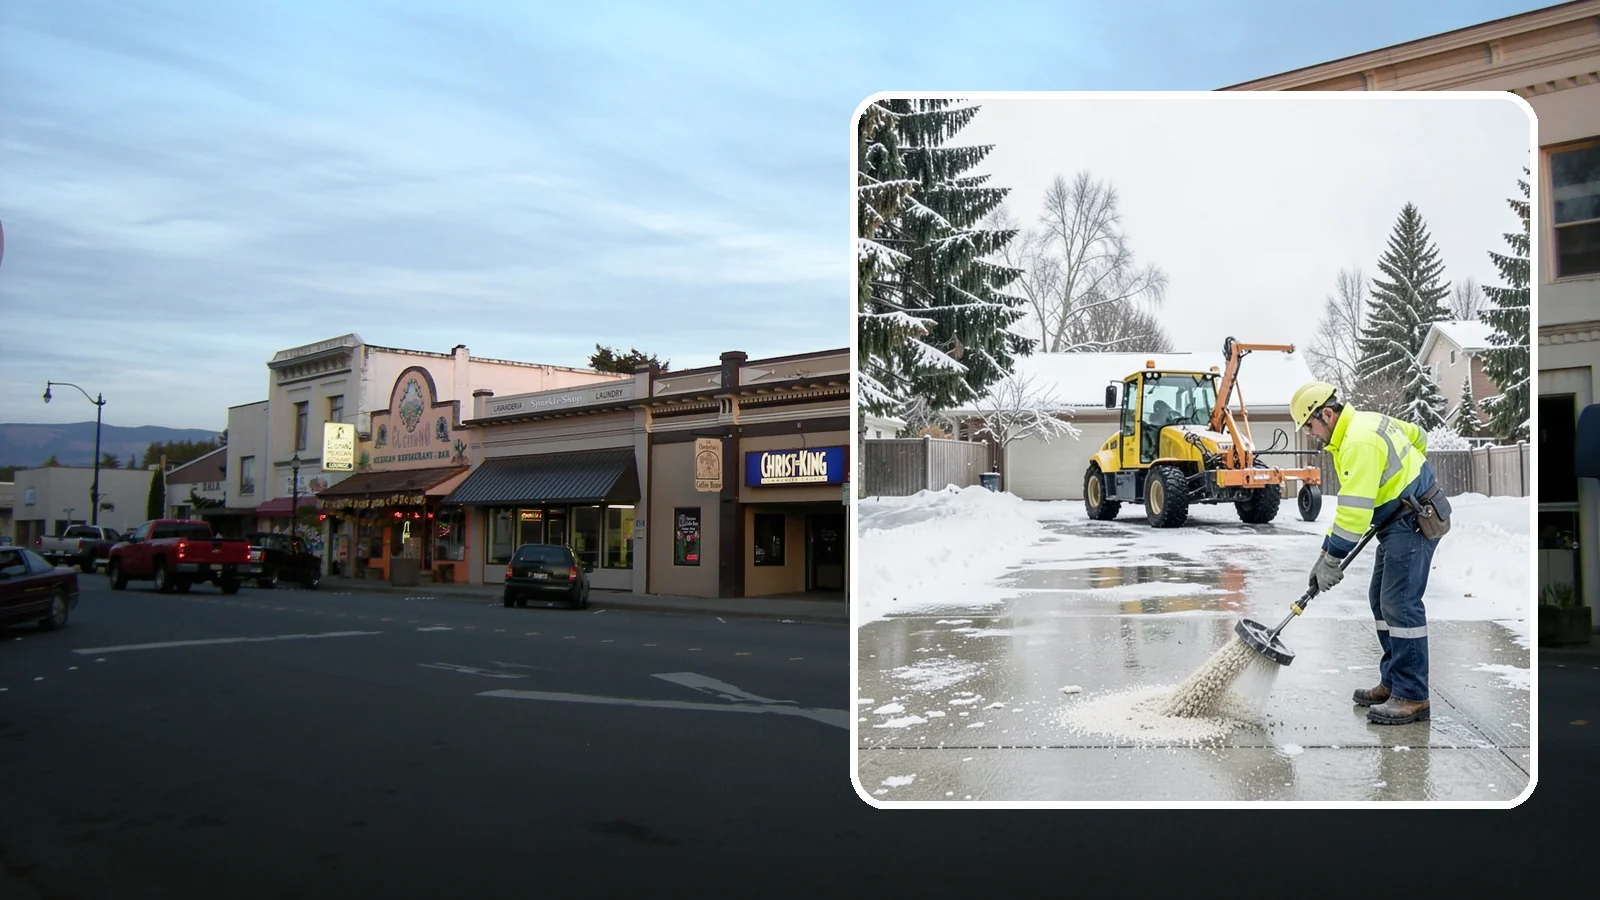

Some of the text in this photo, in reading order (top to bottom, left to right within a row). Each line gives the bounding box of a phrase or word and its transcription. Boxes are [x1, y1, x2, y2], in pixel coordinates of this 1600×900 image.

[531, 394, 582, 408] Sparkle Shop
[595, 388, 623, 400] LAUNDRY
[493, 402, 522, 413] LAVANDERIA
[373, 454, 396, 464] MEXICAN
[397, 451, 433, 462] RESTAURANT
[437, 450, 450, 459] BAR
[761, 450, 827, 478] CHRIST KING
